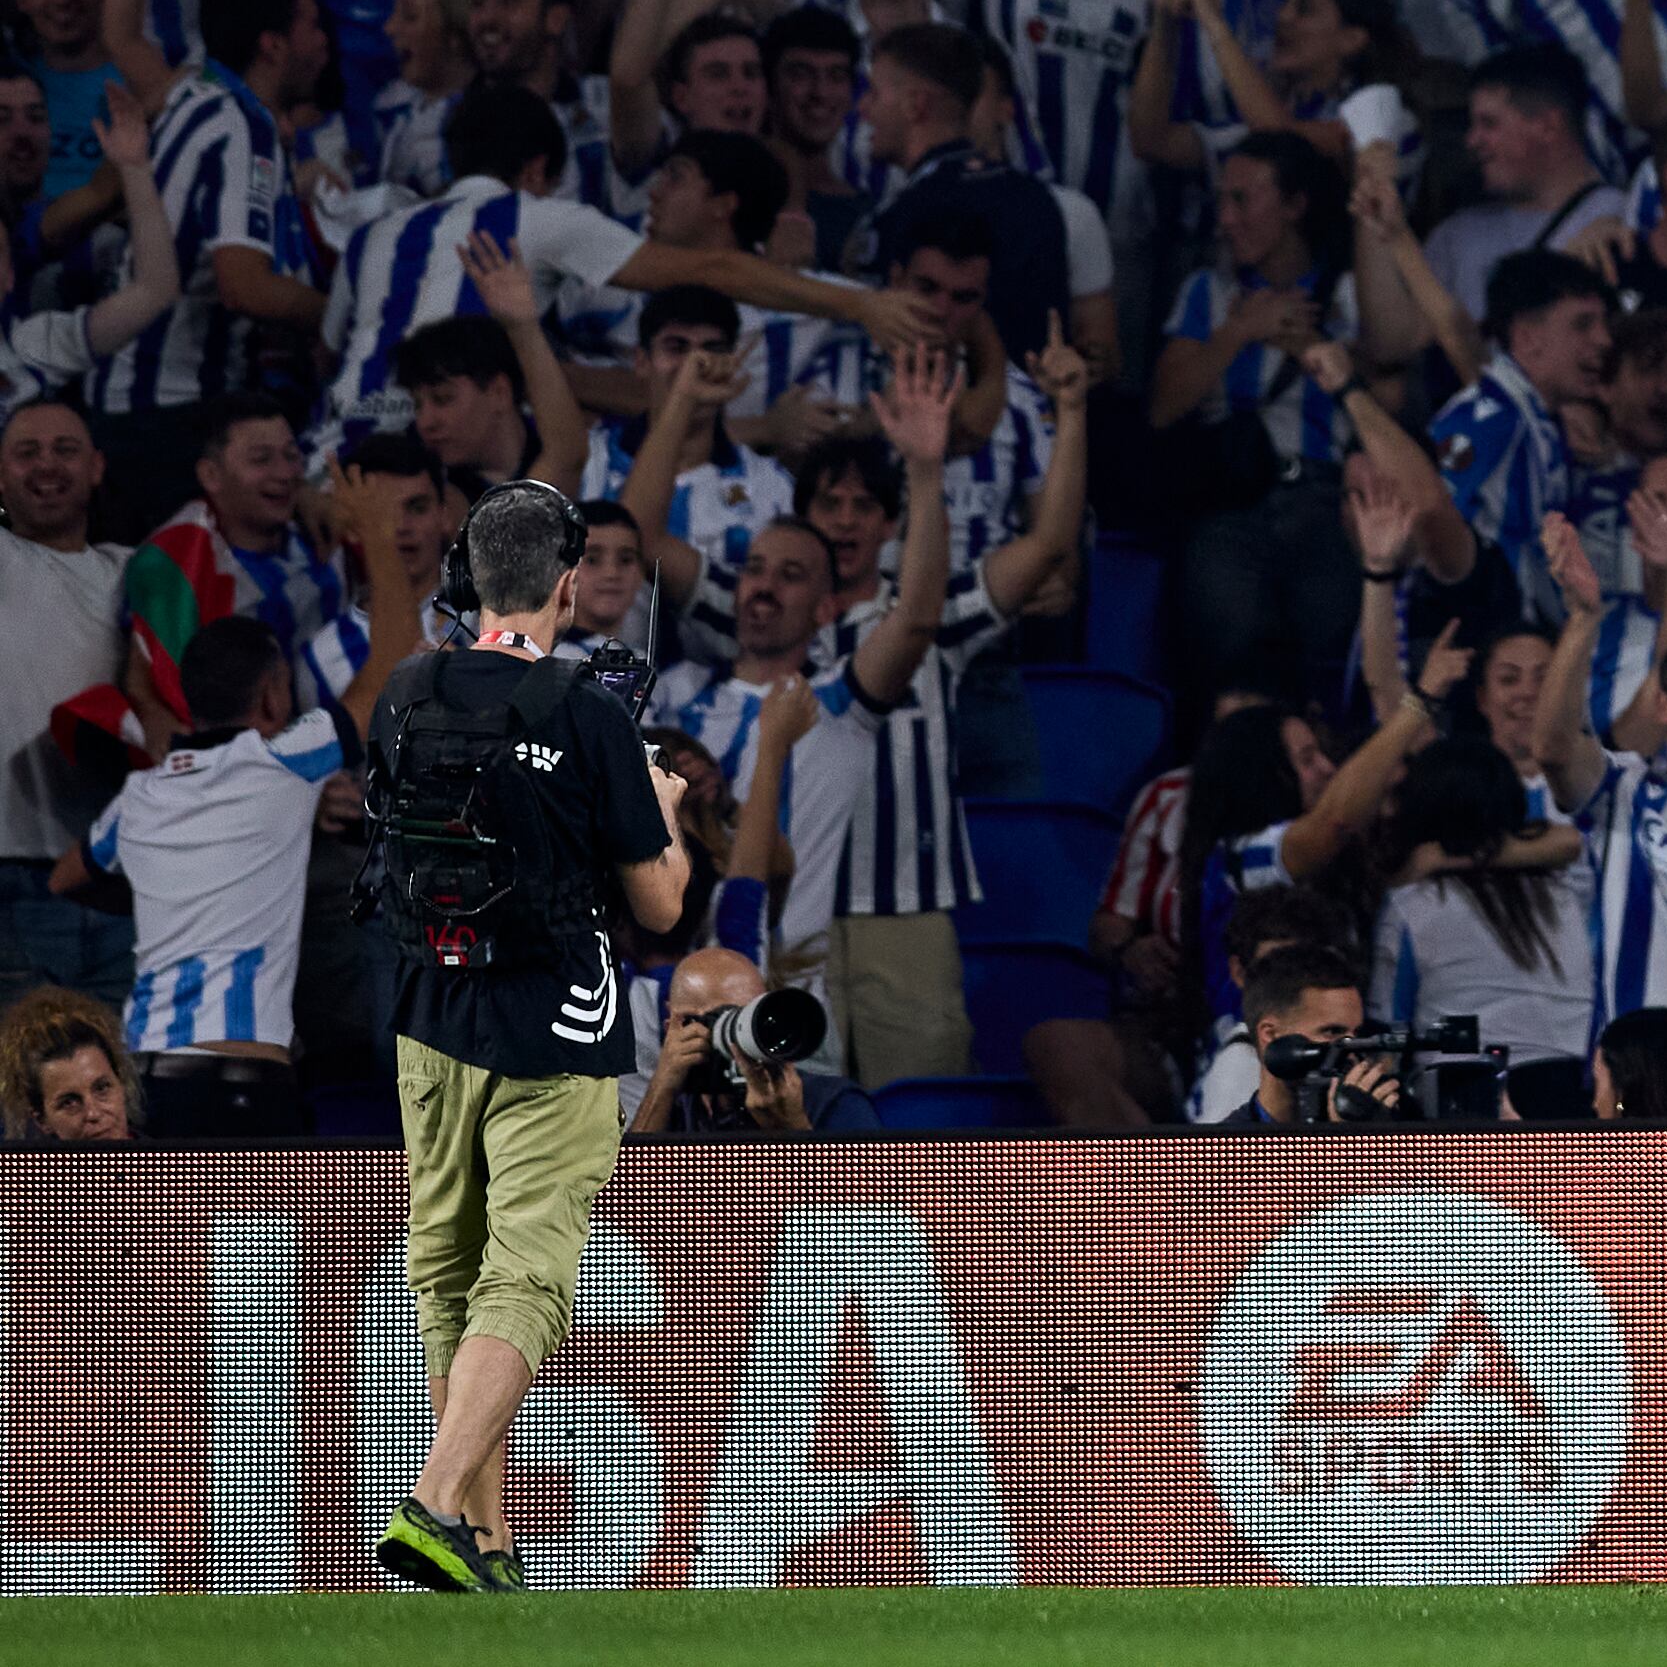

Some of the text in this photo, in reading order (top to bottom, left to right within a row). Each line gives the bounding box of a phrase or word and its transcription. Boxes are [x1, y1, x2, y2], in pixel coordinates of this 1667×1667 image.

[0, 1206, 1022, 1596] IGA
[1282, 1287, 1548, 1419] EA
[1272, 1432, 1562, 1494] SPORTS
